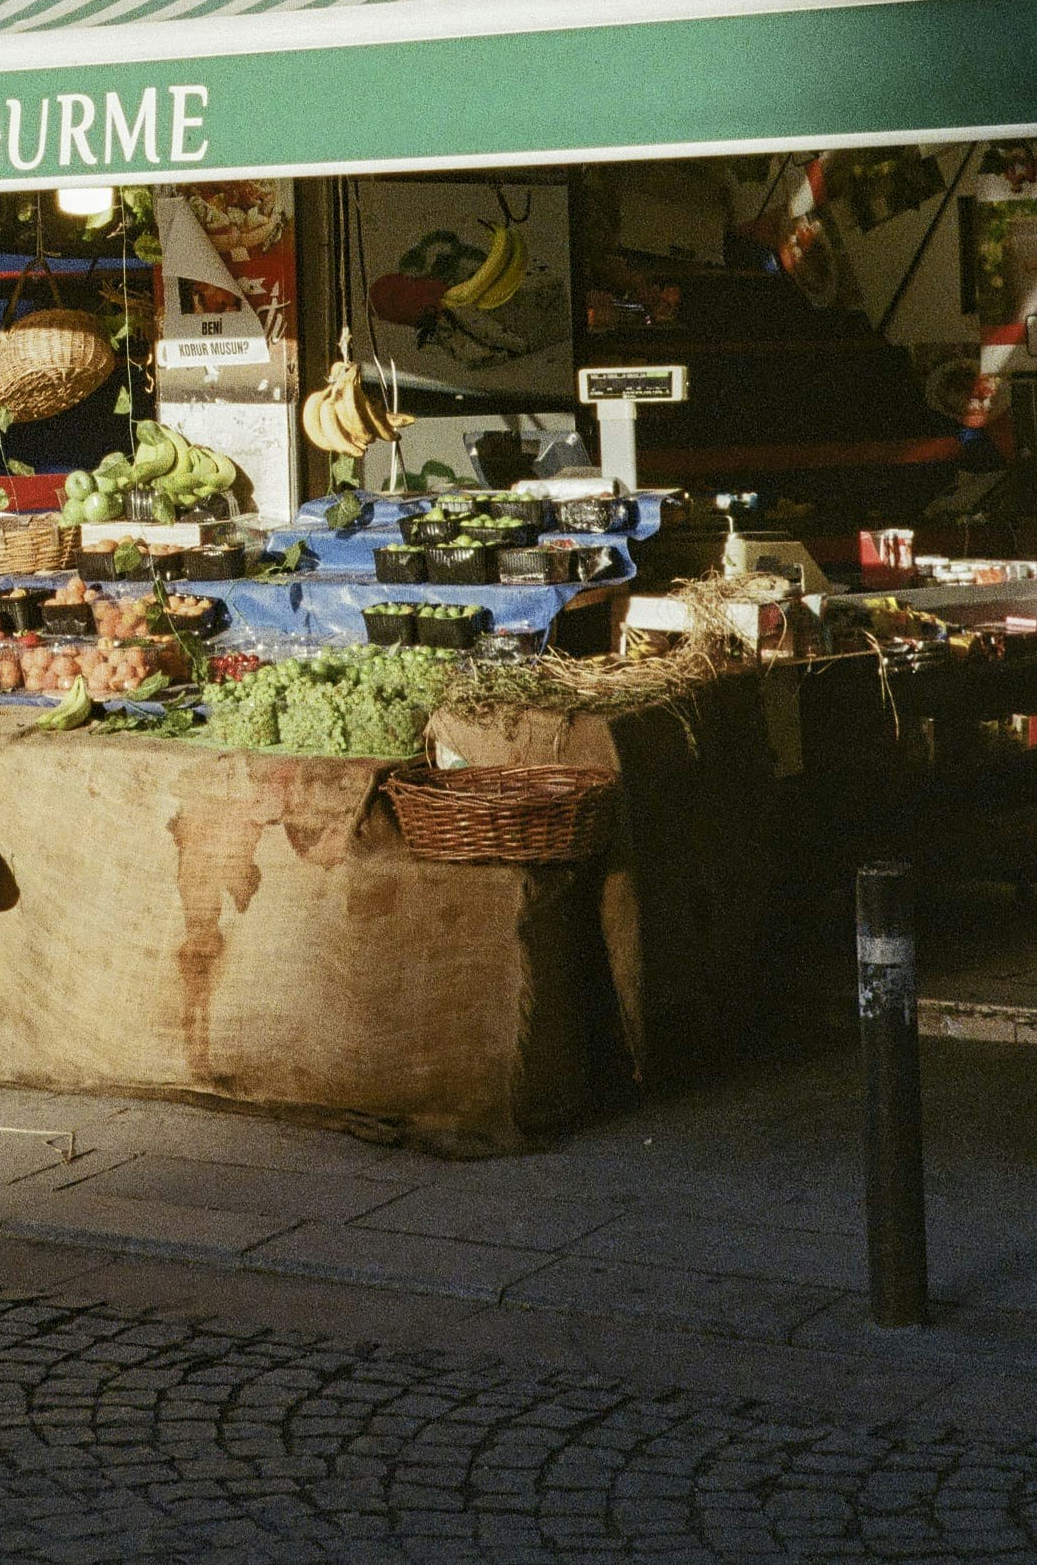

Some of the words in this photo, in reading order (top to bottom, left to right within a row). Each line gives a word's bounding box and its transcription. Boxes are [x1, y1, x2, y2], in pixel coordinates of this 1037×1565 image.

[202, 318, 222, 335] BENİ
[179, 342, 208, 357] KORUR
[211, 340, 249, 356] MUSUN?
